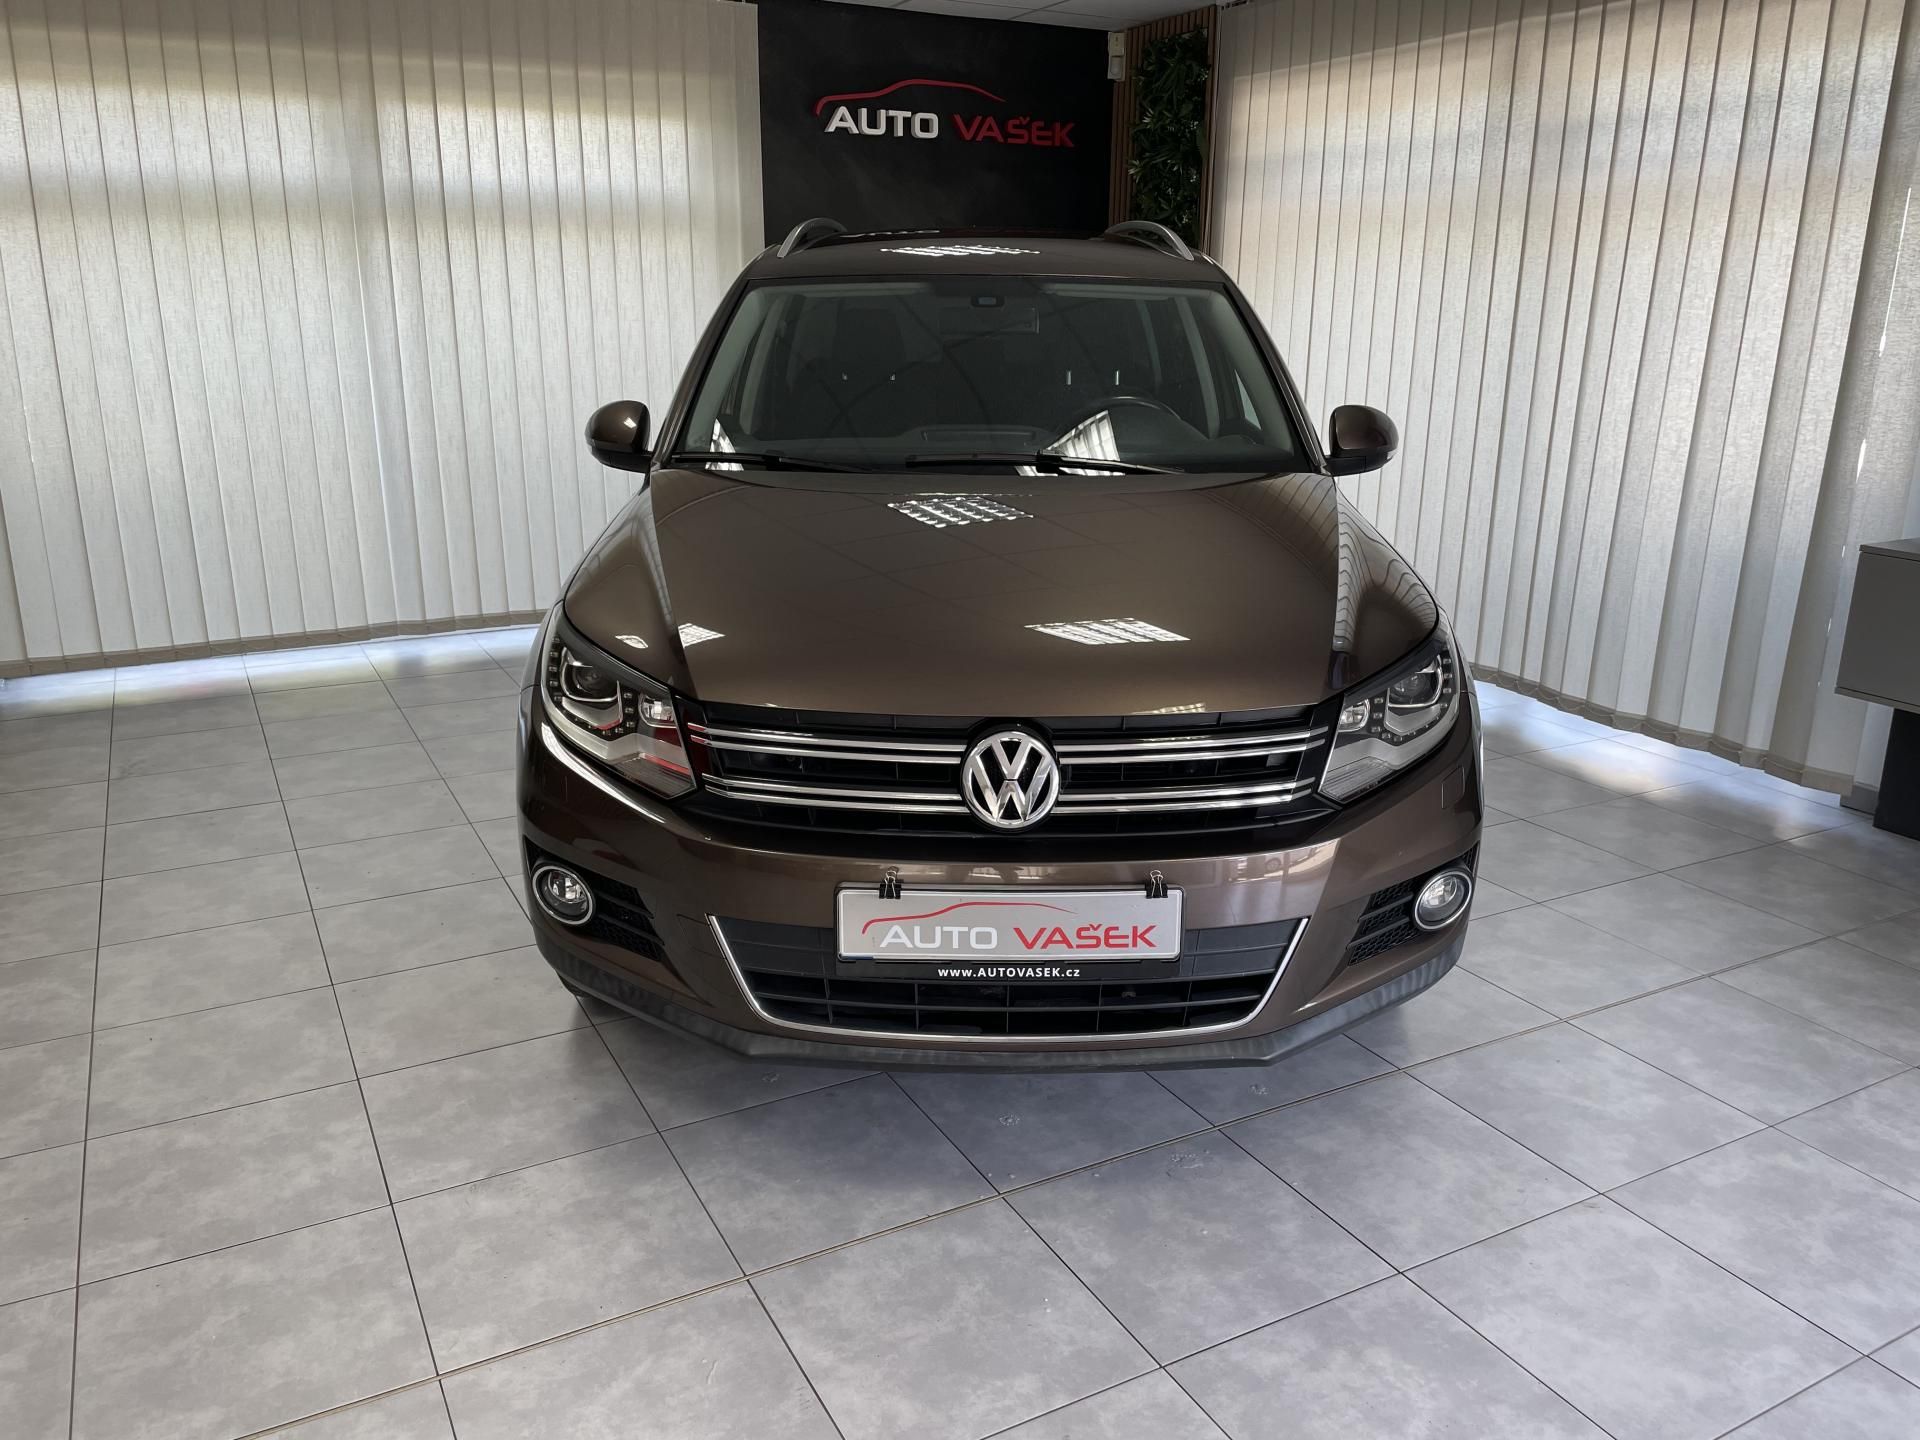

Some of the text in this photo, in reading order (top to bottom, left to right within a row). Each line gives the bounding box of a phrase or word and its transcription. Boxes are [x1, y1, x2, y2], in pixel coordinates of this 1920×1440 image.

[825, 106, 1074, 147] AUTO VAŠEK
[880, 923, 1157, 950] AUTO VAŠEK
[937, 966, 1081, 978] www.AUTOVASEK.cz
